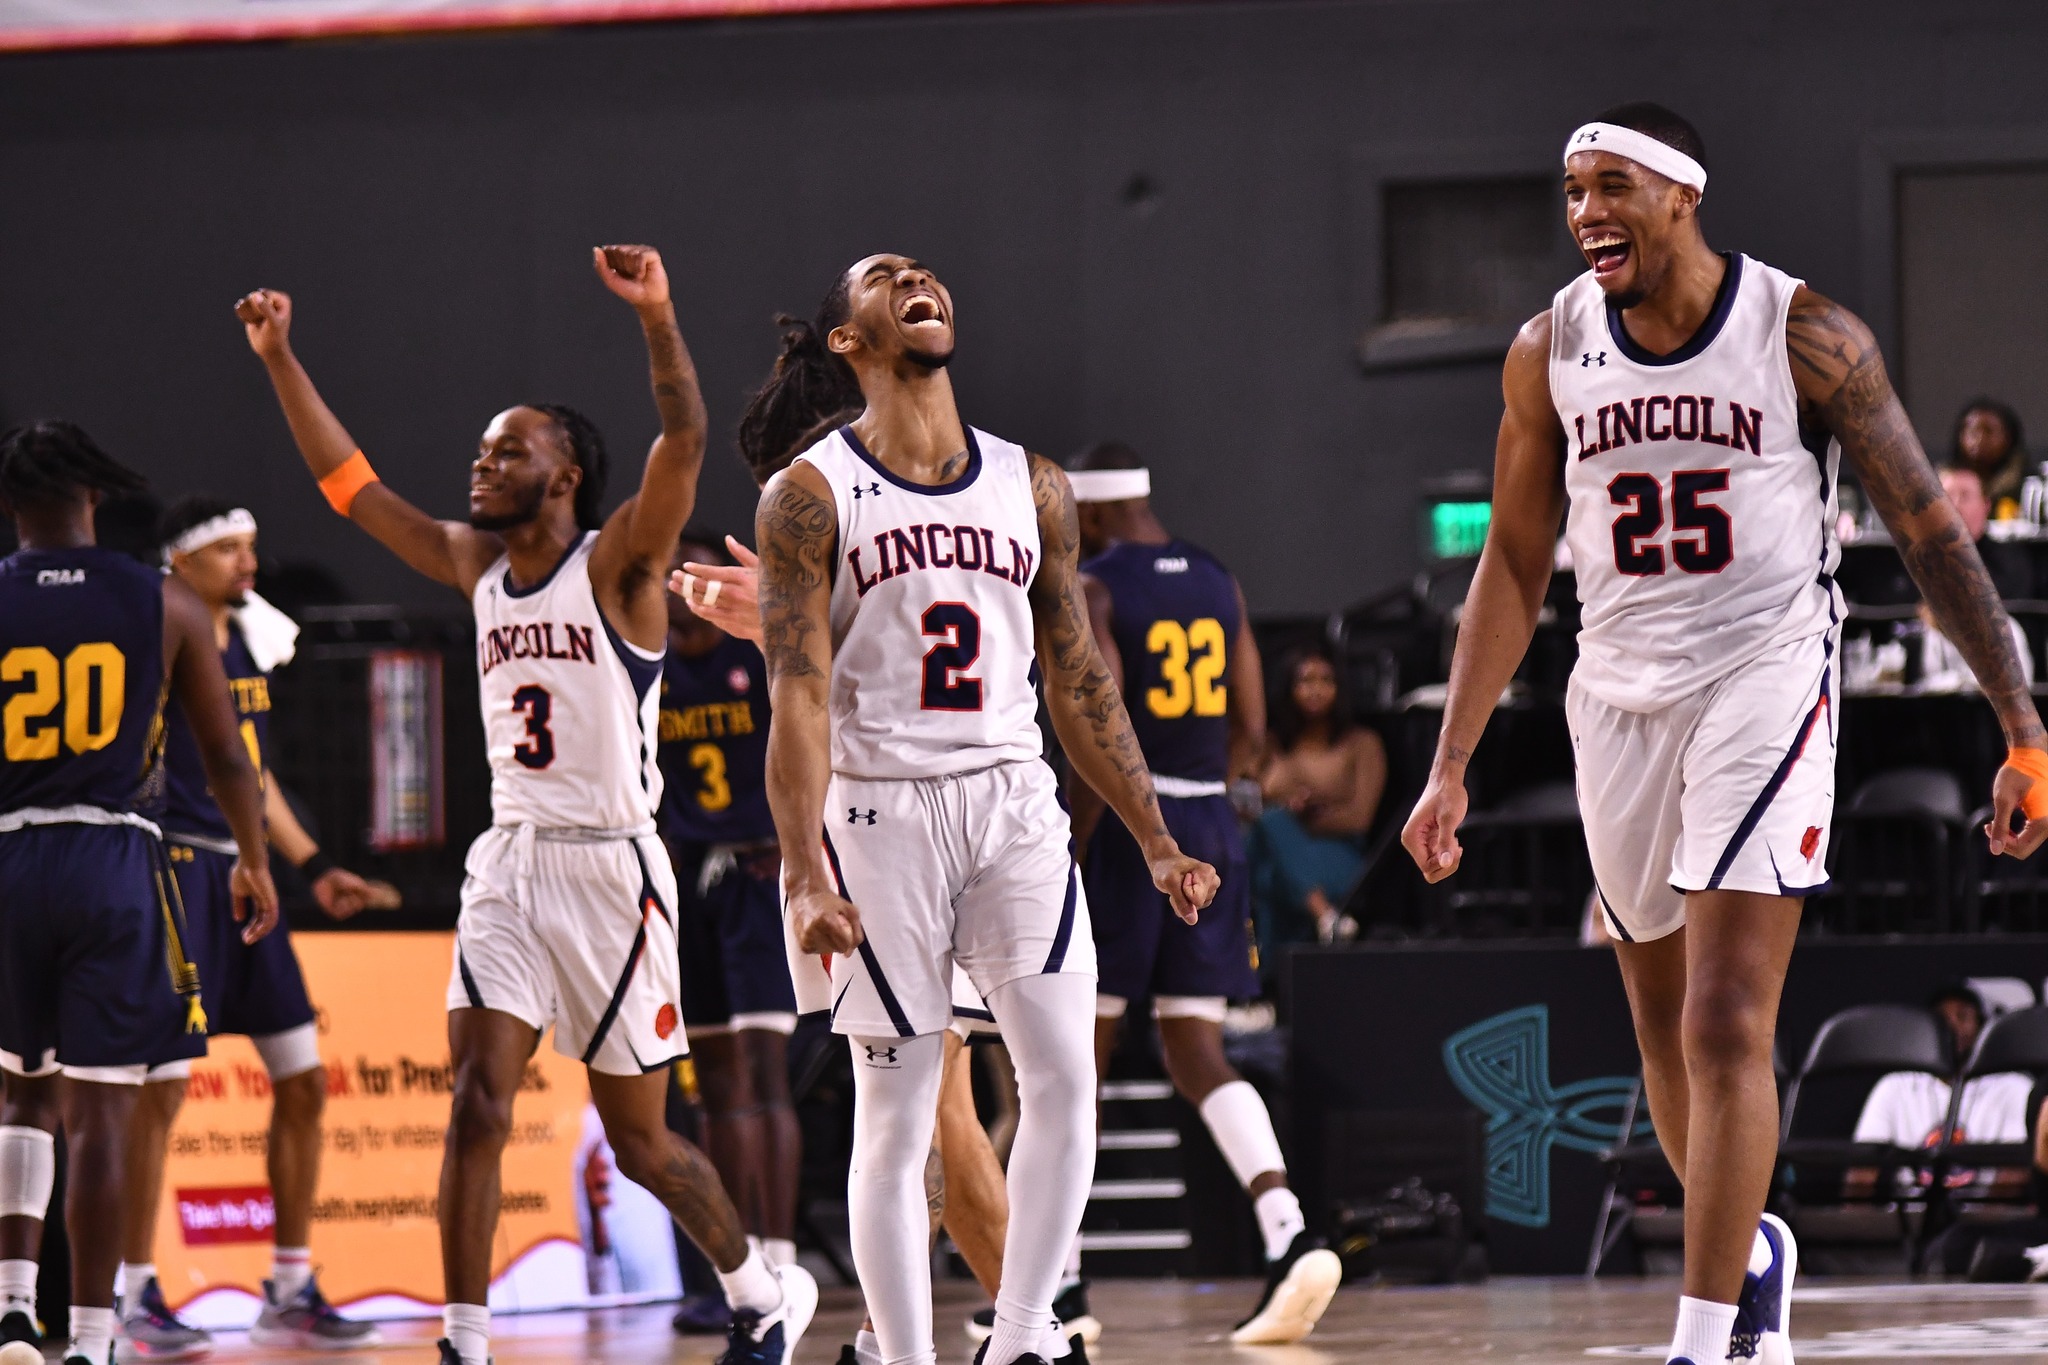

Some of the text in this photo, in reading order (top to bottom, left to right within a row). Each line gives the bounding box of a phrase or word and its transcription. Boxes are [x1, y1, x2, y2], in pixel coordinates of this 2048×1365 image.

[1575, 394, 1763, 463] LINCOLN
[1607, 468, 1734, 577] 25
[37, 569, 86, 587] CIAA
[847, 523, 1033, 600] LINCOLN
[482, 622, 596, 677] LINCOLN
[920, 601, 983, 712] 2
[1145, 617, 1228, 720] 32
[0, 641, 126, 762] 20
[512, 683, 556, 771] 3
[659, 701, 755, 742] SMITH
[688, 742, 732, 813] 3
